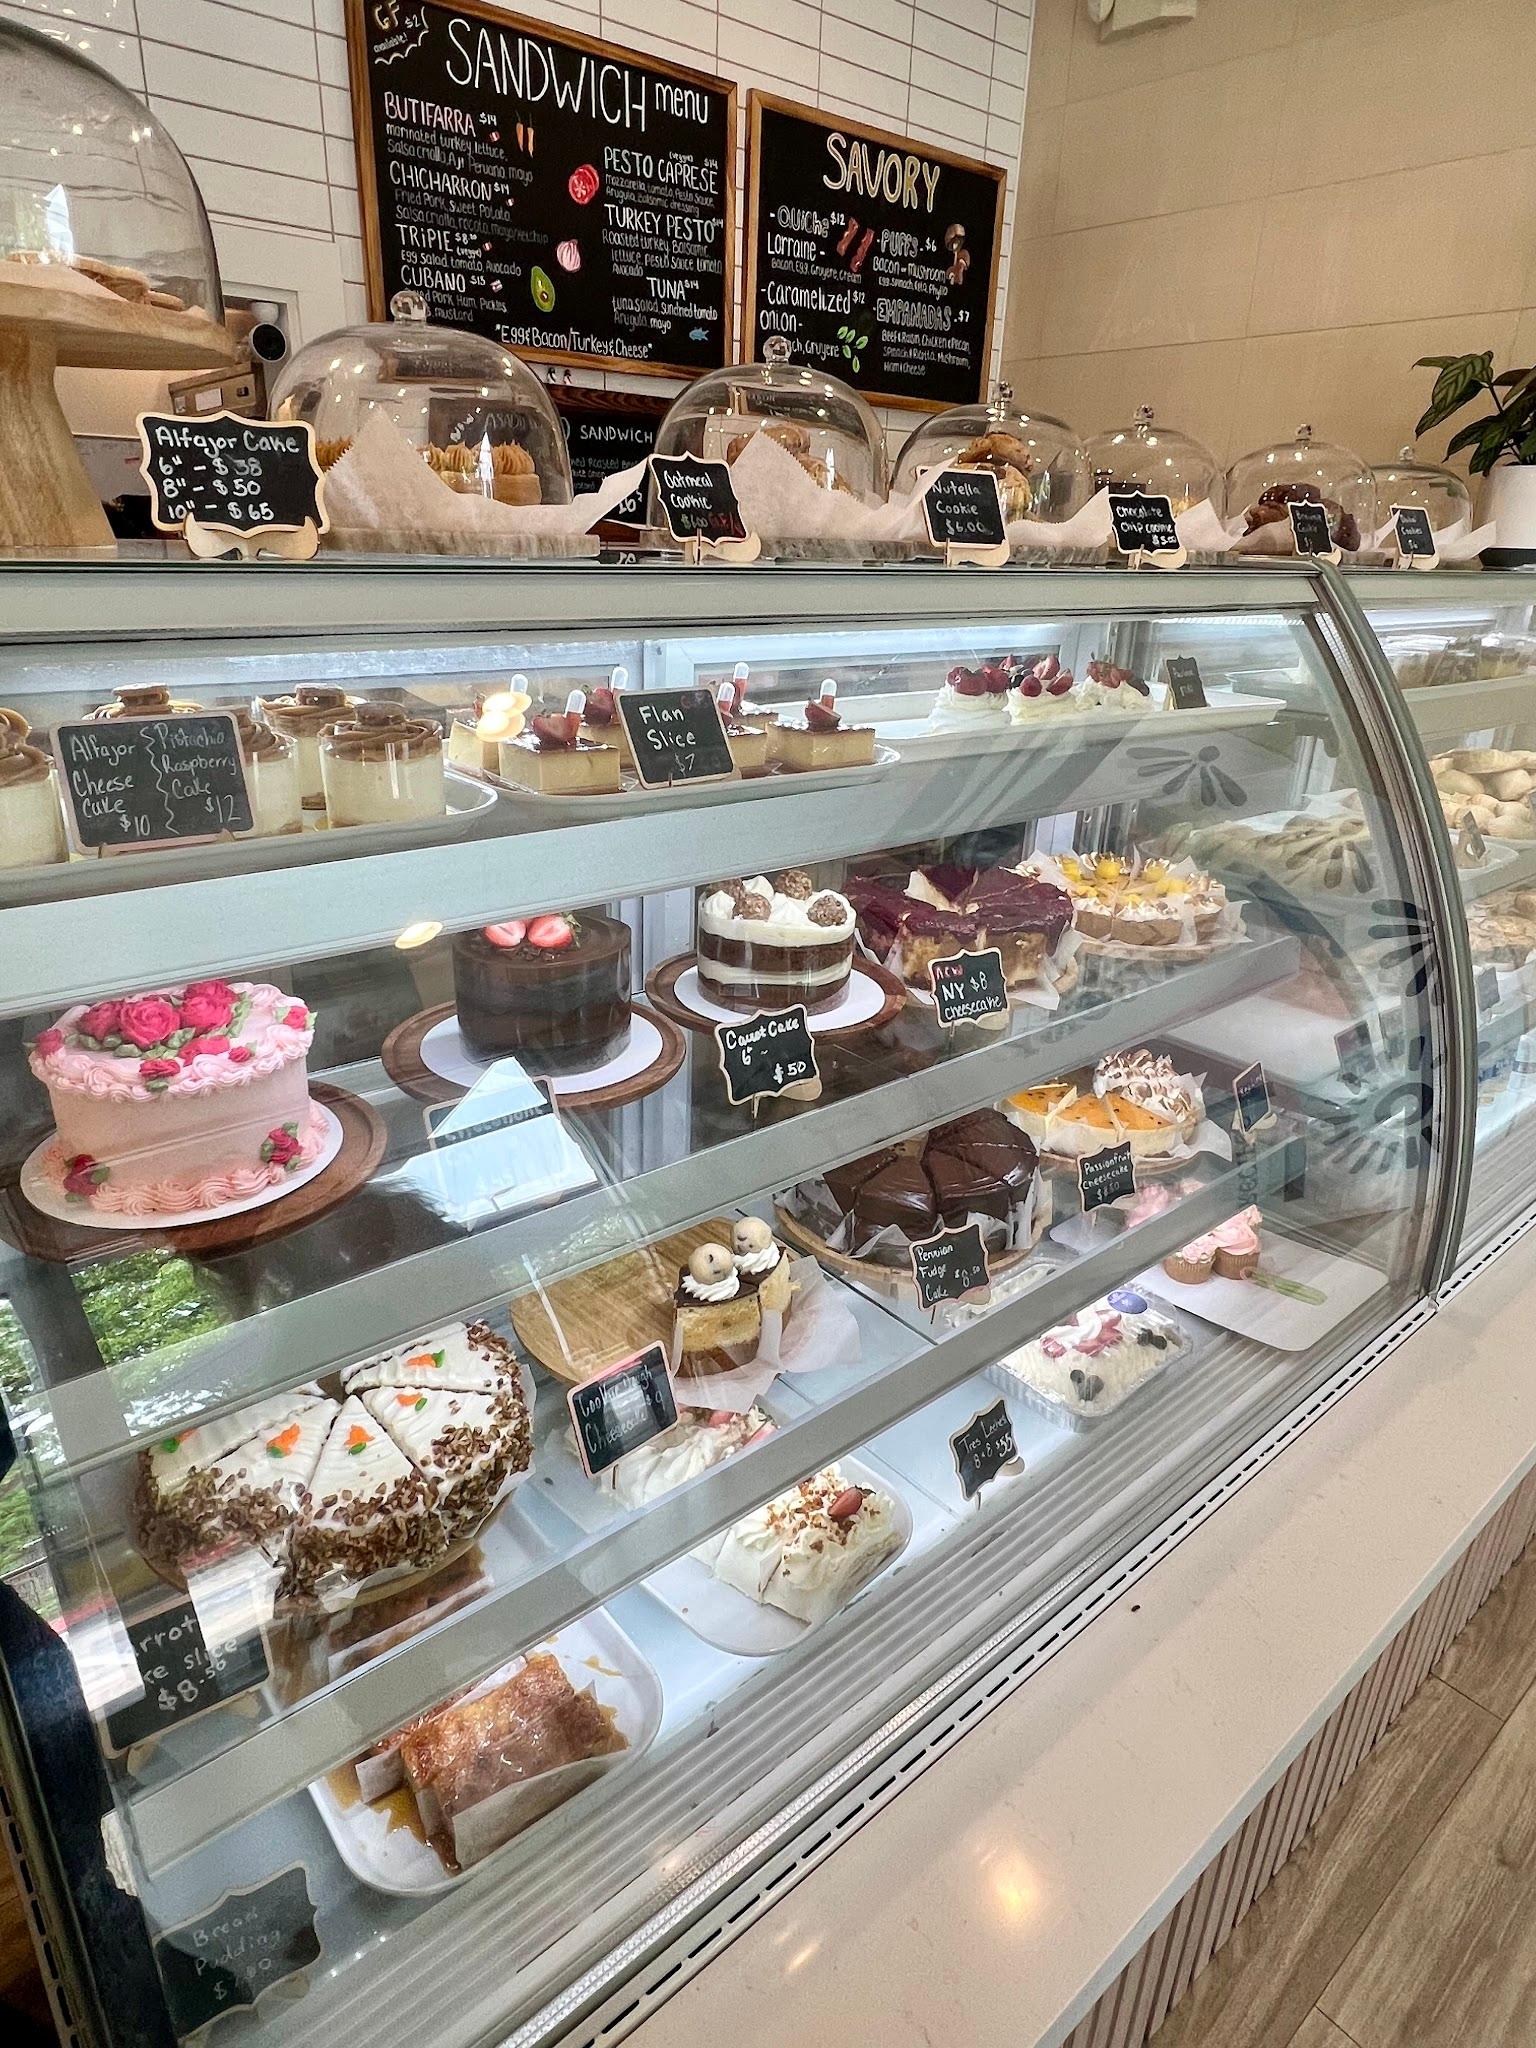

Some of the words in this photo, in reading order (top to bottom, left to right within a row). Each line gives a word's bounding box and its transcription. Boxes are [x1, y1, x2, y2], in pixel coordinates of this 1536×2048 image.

[446, 18, 646, 132] SANDWICH
[655, 82, 709, 124] menu
[384, 91, 477, 137] BUTIFARRA
[479, 111, 498, 126] $14
[386, 123, 437, 145] marinated
[389, 160, 492, 201] CHICHARRON
[493, 181, 510, 195] $14
[604, 146, 654, 179] PESTO
[657, 159, 719, 195] CAPRESE
[822, 132, 941, 213] SAVORY
[394, 188, 422, 206] Fried
[669, 199, 700, 219] dressing
[829, 211, 846, 226] $12
[603, 203, 661, 235] TURKEY
[666, 214, 715, 244] PESTO
[602, 228, 640, 248] Roasted
[767, 231, 817, 262] Lorraine
[925, 236, 938, 253] $6
[401, 249, 418, 265] Egg
[486, 260, 522, 277] Avocado
[611, 262, 644, 277] Avocado
[872, 255, 900, 276] Bacon
[400, 264, 466, 293] CUBANO
[645, 276, 686, 301] TUNA
[684, 279, 700, 290] $14
[851, 289, 866, 305] $12
[805, 339, 840, 362] Gruyere
[155, 425, 238, 459] Alfajor
[242, 429, 300, 454] Cake
[580, 424, 653, 444] SANDWICH
[663, 469, 714, 489] Oatmeal
[931, 480, 982, 497] Nutella
[935, 500, 979, 515] Cookie
[638, 703, 685, 725] Flan
[152, 722, 226, 750] Pistachio
[646, 728, 697, 751] Slice
[70, 733, 137, 766] Alfajor
[161, 754, 237, 776] Raspberry
[72, 767, 135, 798] Cheese
[171, 778, 212, 800] Cake
[82, 796, 128, 819] Cake
[204, 794, 241, 824] $12
[119, 813, 151, 837] $10
[941, 982, 965, 1002] NY
[969, 970, 988, 992] $8
[767, 1018, 800, 1038] Cake
[918, 1263, 947, 1279] Fudge
[925, 1283, 950, 1302] Cake
[957, 1433, 982, 1454] Tres
[980, 1414, 1008, 1439] Leches
[136, 1614, 200, 1656] rrot
